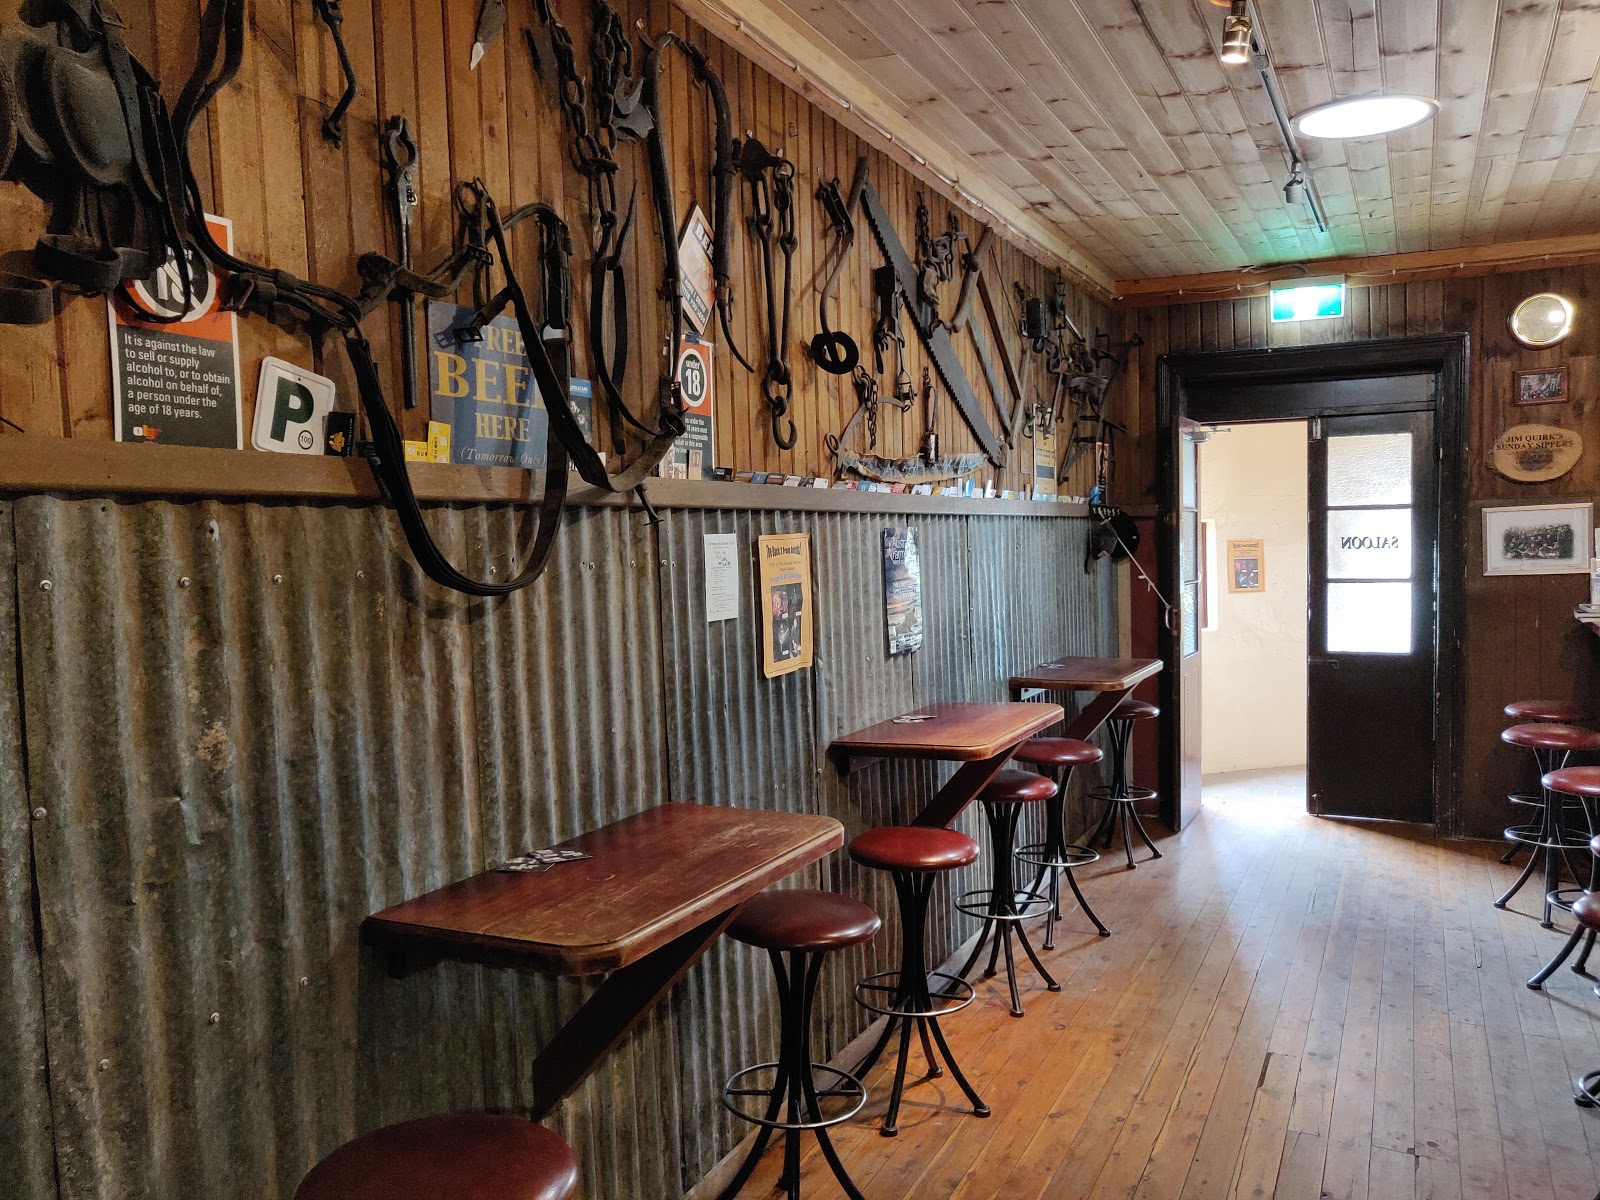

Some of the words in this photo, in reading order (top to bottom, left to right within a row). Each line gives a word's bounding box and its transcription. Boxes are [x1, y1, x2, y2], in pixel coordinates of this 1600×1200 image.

[694, 219, 714, 262] BEE
[124, 333, 132, 345] It
[134, 334, 143, 347] is
[145, 339, 181, 353] against
[181, 343, 197, 354] the
[198, 345, 216, 357] law
[474, 325, 527, 357] REE
[125, 348, 136, 358] to
[138, 350, 155, 361] sell
[157, 354, 167, 362] or
[169, 355, 200, 369] supply
[685, 359, 700, 370] under
[126, 361, 163, 374] alcohol
[164, 367, 178, 379] to,
[180, 370, 190, 379] or
[191, 370, 201, 380] to
[203, 371, 230, 385] obtain
[685, 368, 701, 396] 18
[127, 375, 164, 388] alcohol
[166, 381, 178, 390] on
[180, 380, 209, 394] behalf
[211, 385, 222, 398] of,
[128, 390, 134, 398] a
[136, 391, 171, 402] person
[173, 393, 201, 406] under
[202, 397, 217, 408] the
[270, 376, 314, 443] P
[128, 403, 146, 415] age
[149, 403, 160, 415] of
[161, 405, 172, 416] 18
[173, 408, 203, 419] years.
[474, 412, 531, 443] HERE
[1505, 435, 1522, 443] JIM
[1525, 433, 1564, 442] QUIRK'S
[300, 435, 312, 445] 100
[1496, 442, 1534, 451] SUNDAY
[1535, 440, 1574, 449] SIPPERS
